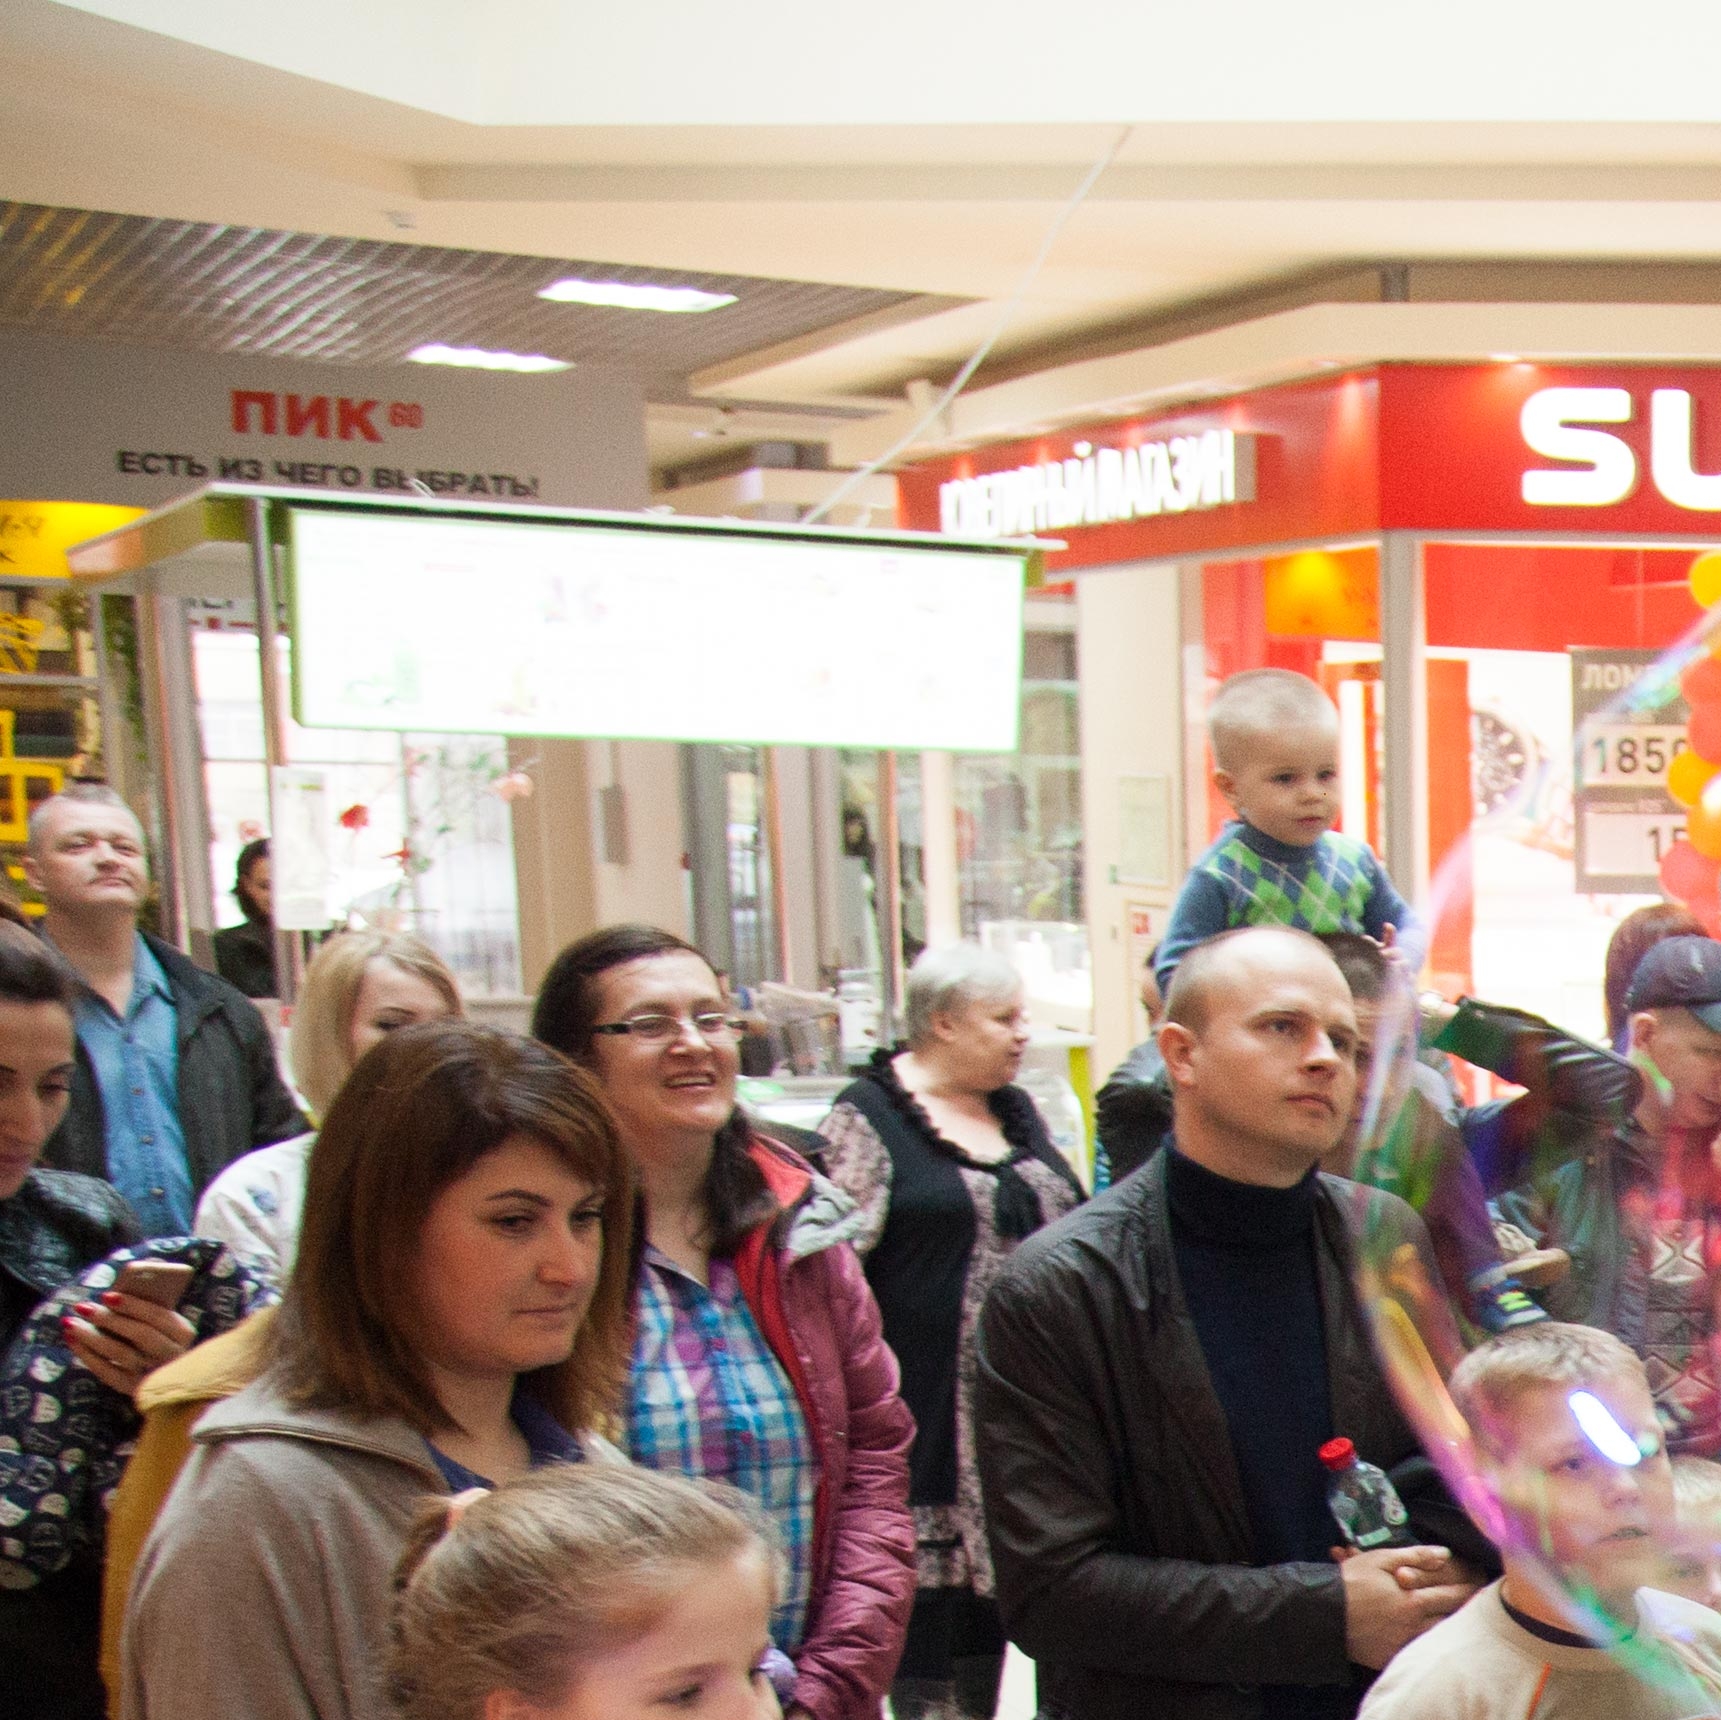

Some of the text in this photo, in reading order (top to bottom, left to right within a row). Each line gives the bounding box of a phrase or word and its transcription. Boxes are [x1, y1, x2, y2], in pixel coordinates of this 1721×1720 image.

[230, 390, 384, 444] ПИК
[116, 449, 540, 499] ЕСТЬ ИЗ ЧЕГО ВЫБРАТЬ!
